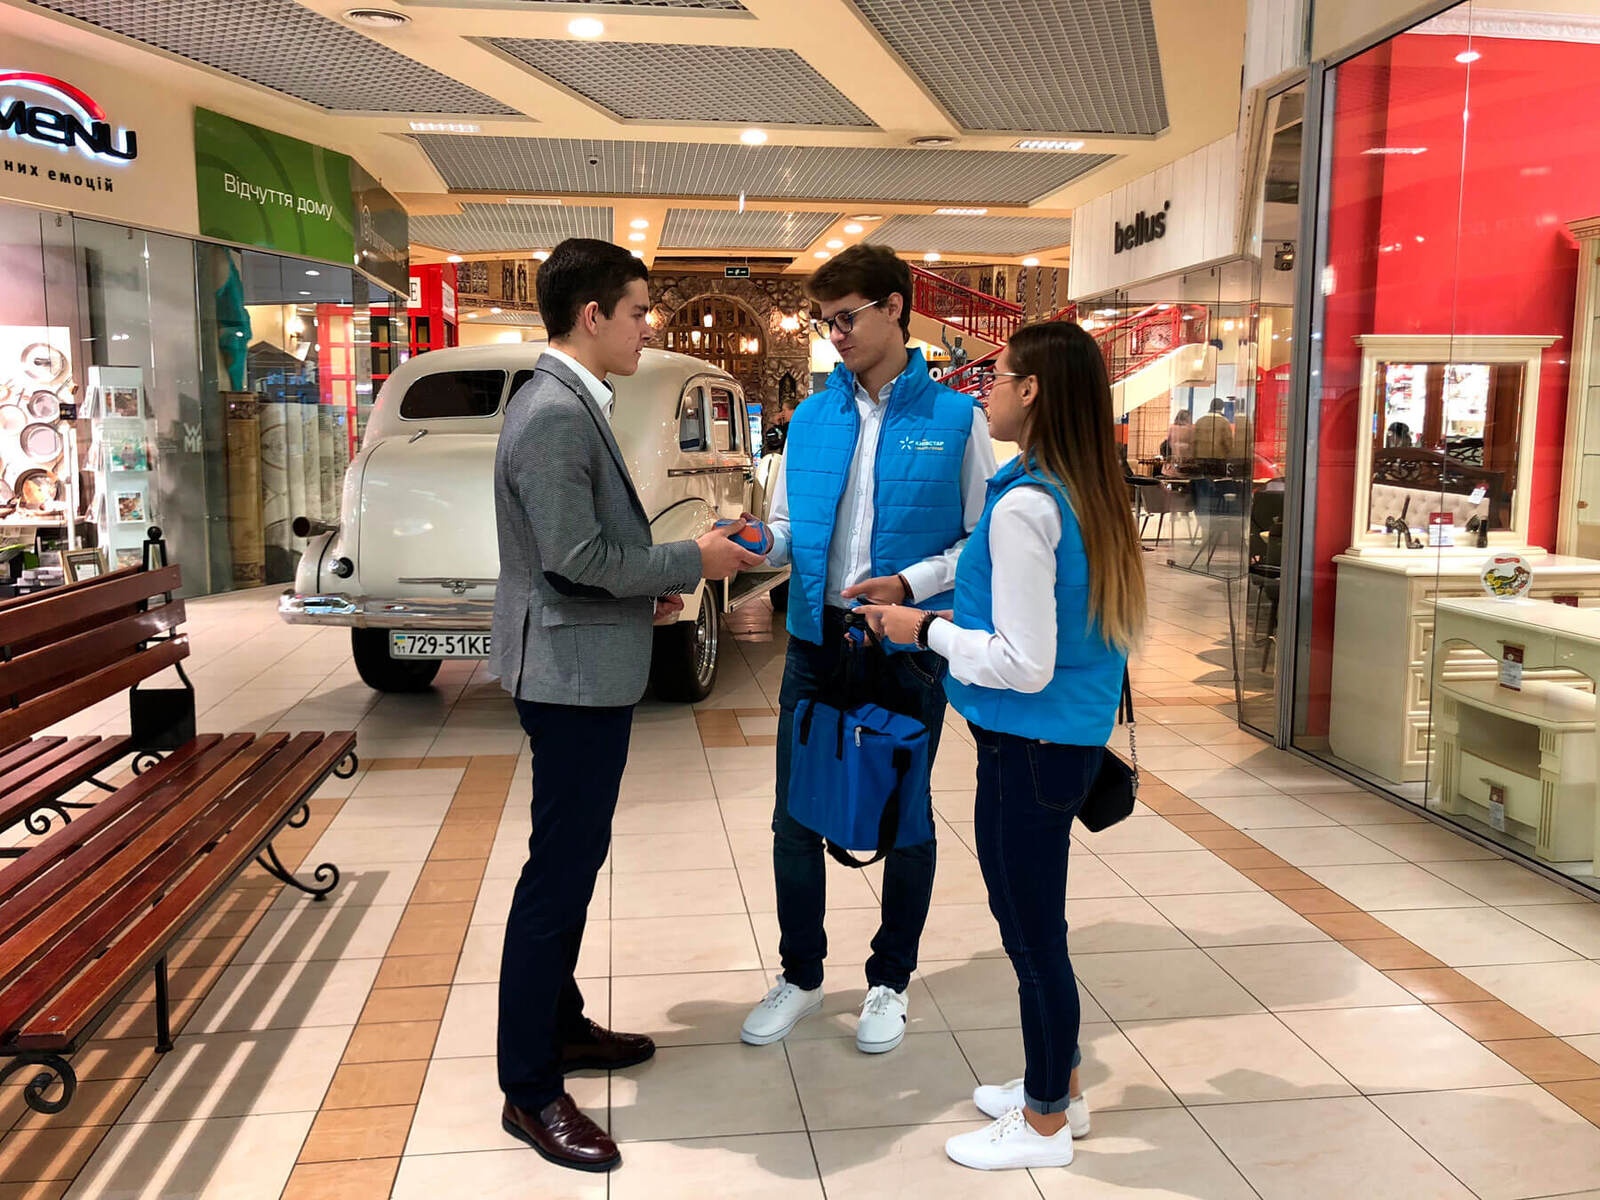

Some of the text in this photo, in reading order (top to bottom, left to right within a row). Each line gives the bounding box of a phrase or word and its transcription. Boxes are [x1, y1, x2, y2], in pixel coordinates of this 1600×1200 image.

[47, 169, 114, 192] емоцій
[224, 172, 333, 221] Відчуття дому
